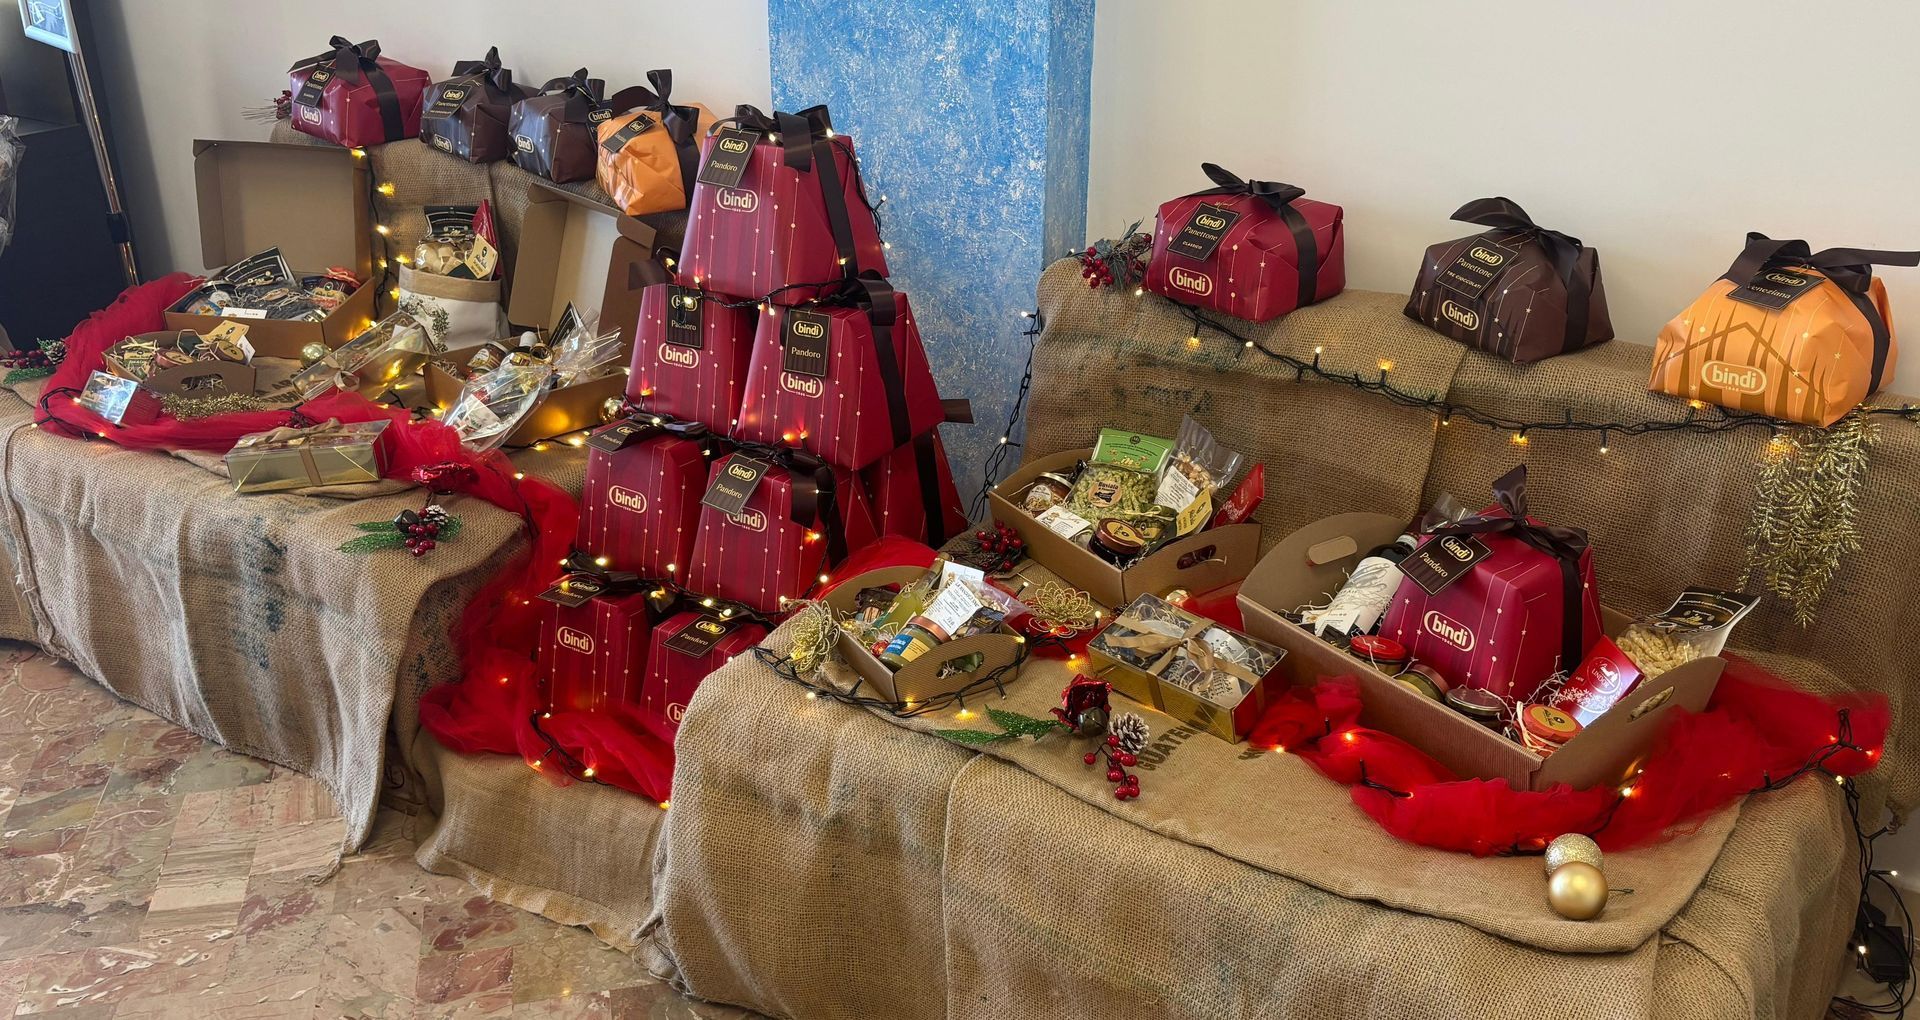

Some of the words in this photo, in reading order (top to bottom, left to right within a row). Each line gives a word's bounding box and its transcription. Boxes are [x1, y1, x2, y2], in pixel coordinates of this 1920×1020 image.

[303, 108, 319, 121] bindi
[592, 110, 612, 120] bindi
[434, 136, 450, 150] bindi
[518, 136, 531, 150] bindi
[723, 140, 744, 150] bindi
[710, 160, 738, 171] Pandoro
[723, 190, 752, 208] bindi
[1200, 216, 1222, 227] bindi
[1185, 226, 1218, 241] Panettone
[1474, 249, 1499, 264] bindi
[1456, 257, 1493, 278] Panettone
[1177, 270, 1206, 292] bindi
[1771, 274, 1800, 286] bindi
[1448, 303, 1474, 327] bindi
[798, 323, 820, 336] bindi
[665, 346, 693, 365] bindi
[791, 346, 821, 359] Pandoro
[787, 373, 817, 394] bindi
[1712, 365, 1757, 389] bindi
[732, 465, 753, 479] bindi
[615, 488, 641, 509] bindi
[716, 483, 743, 499] Pandoro
[1444, 538, 1470, 559] bindi
[1419, 551, 1449, 578] Pandoro
[1431, 614, 1468, 647] bindi
[563, 629, 589, 651] bindi
[680, 632, 709, 646] Pandoro
[1591, 667, 1610, 688] LINDOR
